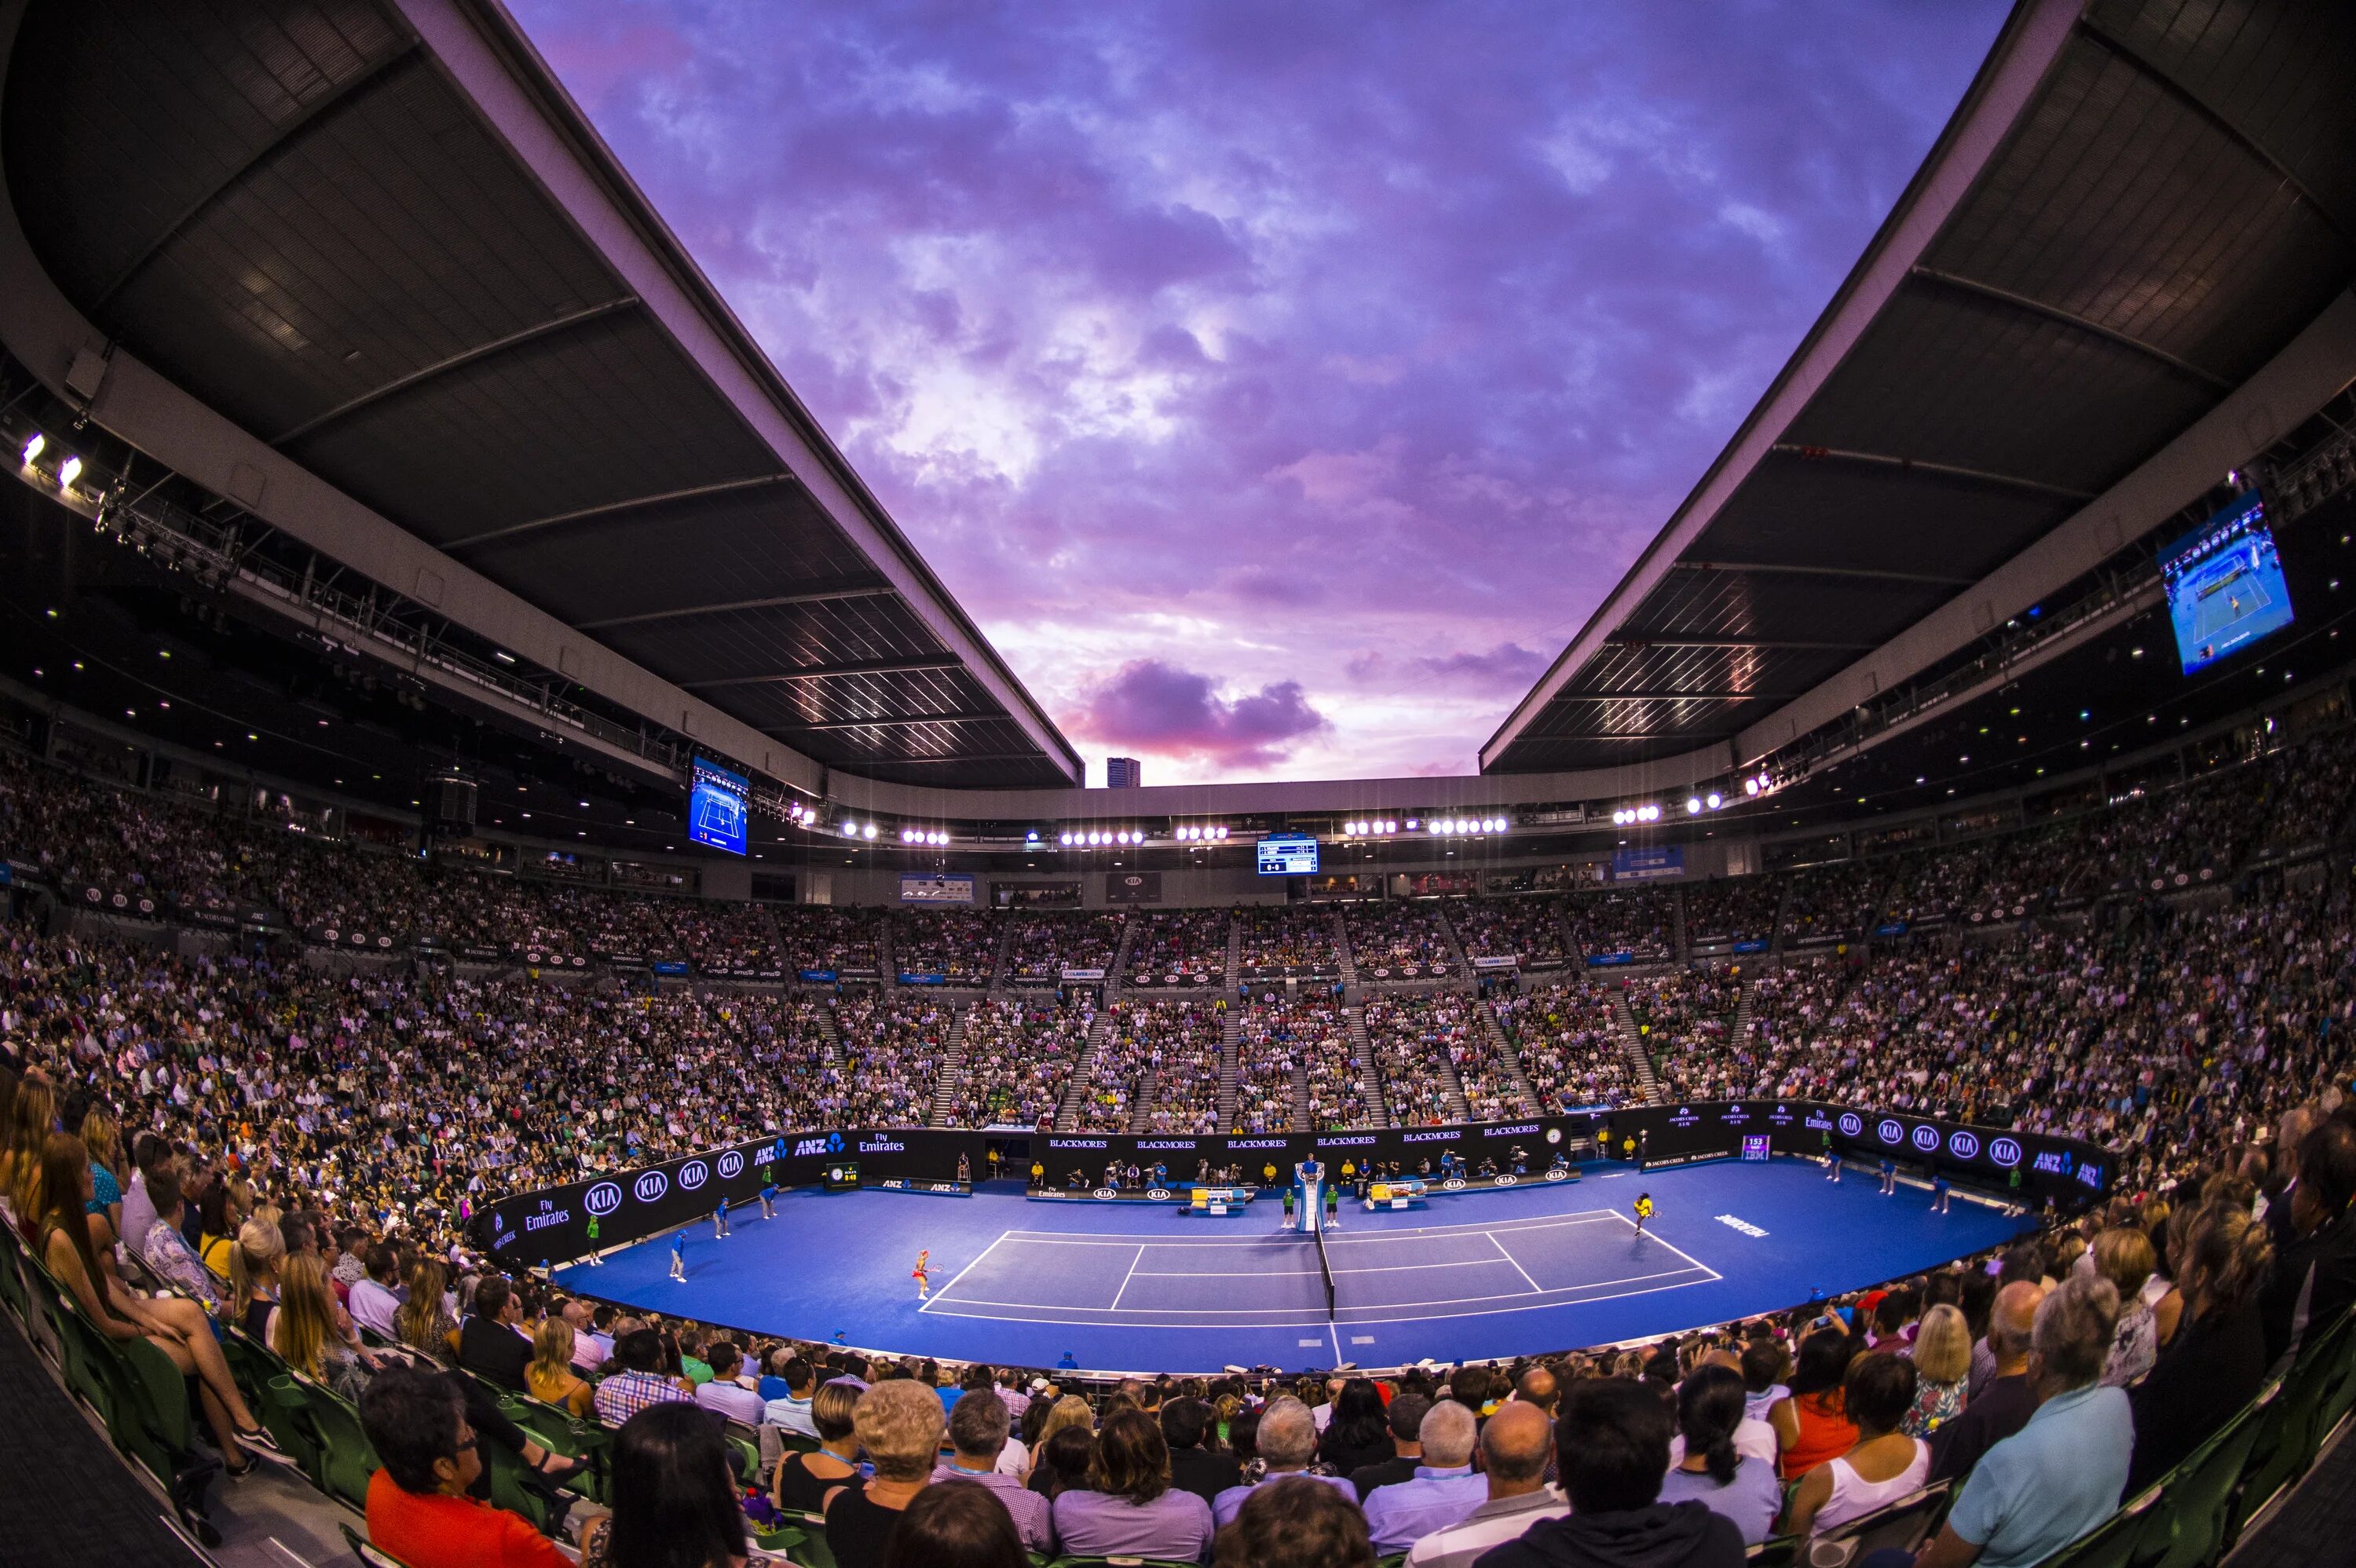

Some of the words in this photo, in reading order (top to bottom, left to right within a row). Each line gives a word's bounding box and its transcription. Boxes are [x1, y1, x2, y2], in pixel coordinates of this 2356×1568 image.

[115, 896, 126, 905] KIA
[142, 901, 152, 910] KIA
[1816, 1109, 1824, 1119] Fly
[1484, 1124, 1538, 1136] BLACKMORES
[1805, 1117, 1832, 1131] Emirates
[1842, 1117, 1857, 1131] KIA
[875, 1133, 887, 1142] Fly
[1403, 1131, 1461, 1142] BLACKMORES
[1882, 1124, 1898, 1139] KIA
[1917, 1130, 1934, 1146] KIA
[794, 1139, 826, 1156] ANZ
[859, 1140, 905, 1152] Emirates
[1050, 1139, 1107, 1148] BLACKMORES
[1227, 1139, 1286, 1149] BLACKMORES
[1317, 1136, 1375, 1146] BLACKMORES
[1954, 1136, 1974, 1153] KIA
[754, 1146, 775, 1166] ANZ
[1746, 1150, 1764, 1160] IBM
[1995, 1143, 2015, 1161] KIA
[723, 1156, 740, 1173] KIA
[2033, 1152, 2061, 1172] ANZ
[683, 1166, 704, 1185] KIA
[1549, 1171, 1564, 1179] KIA
[2076, 1163, 2097, 1188] ANZ
[640, 1177, 663, 1197] KIA
[883, 1179, 902, 1189] ANZ
[930, 1183, 951, 1192] ANZ
[540, 1200, 553, 1211] Fly
[591, 1188, 616, 1210] KIA
[525, 1209, 569, 1231] Emirates
[502, 1230, 516, 1245] CREEK
